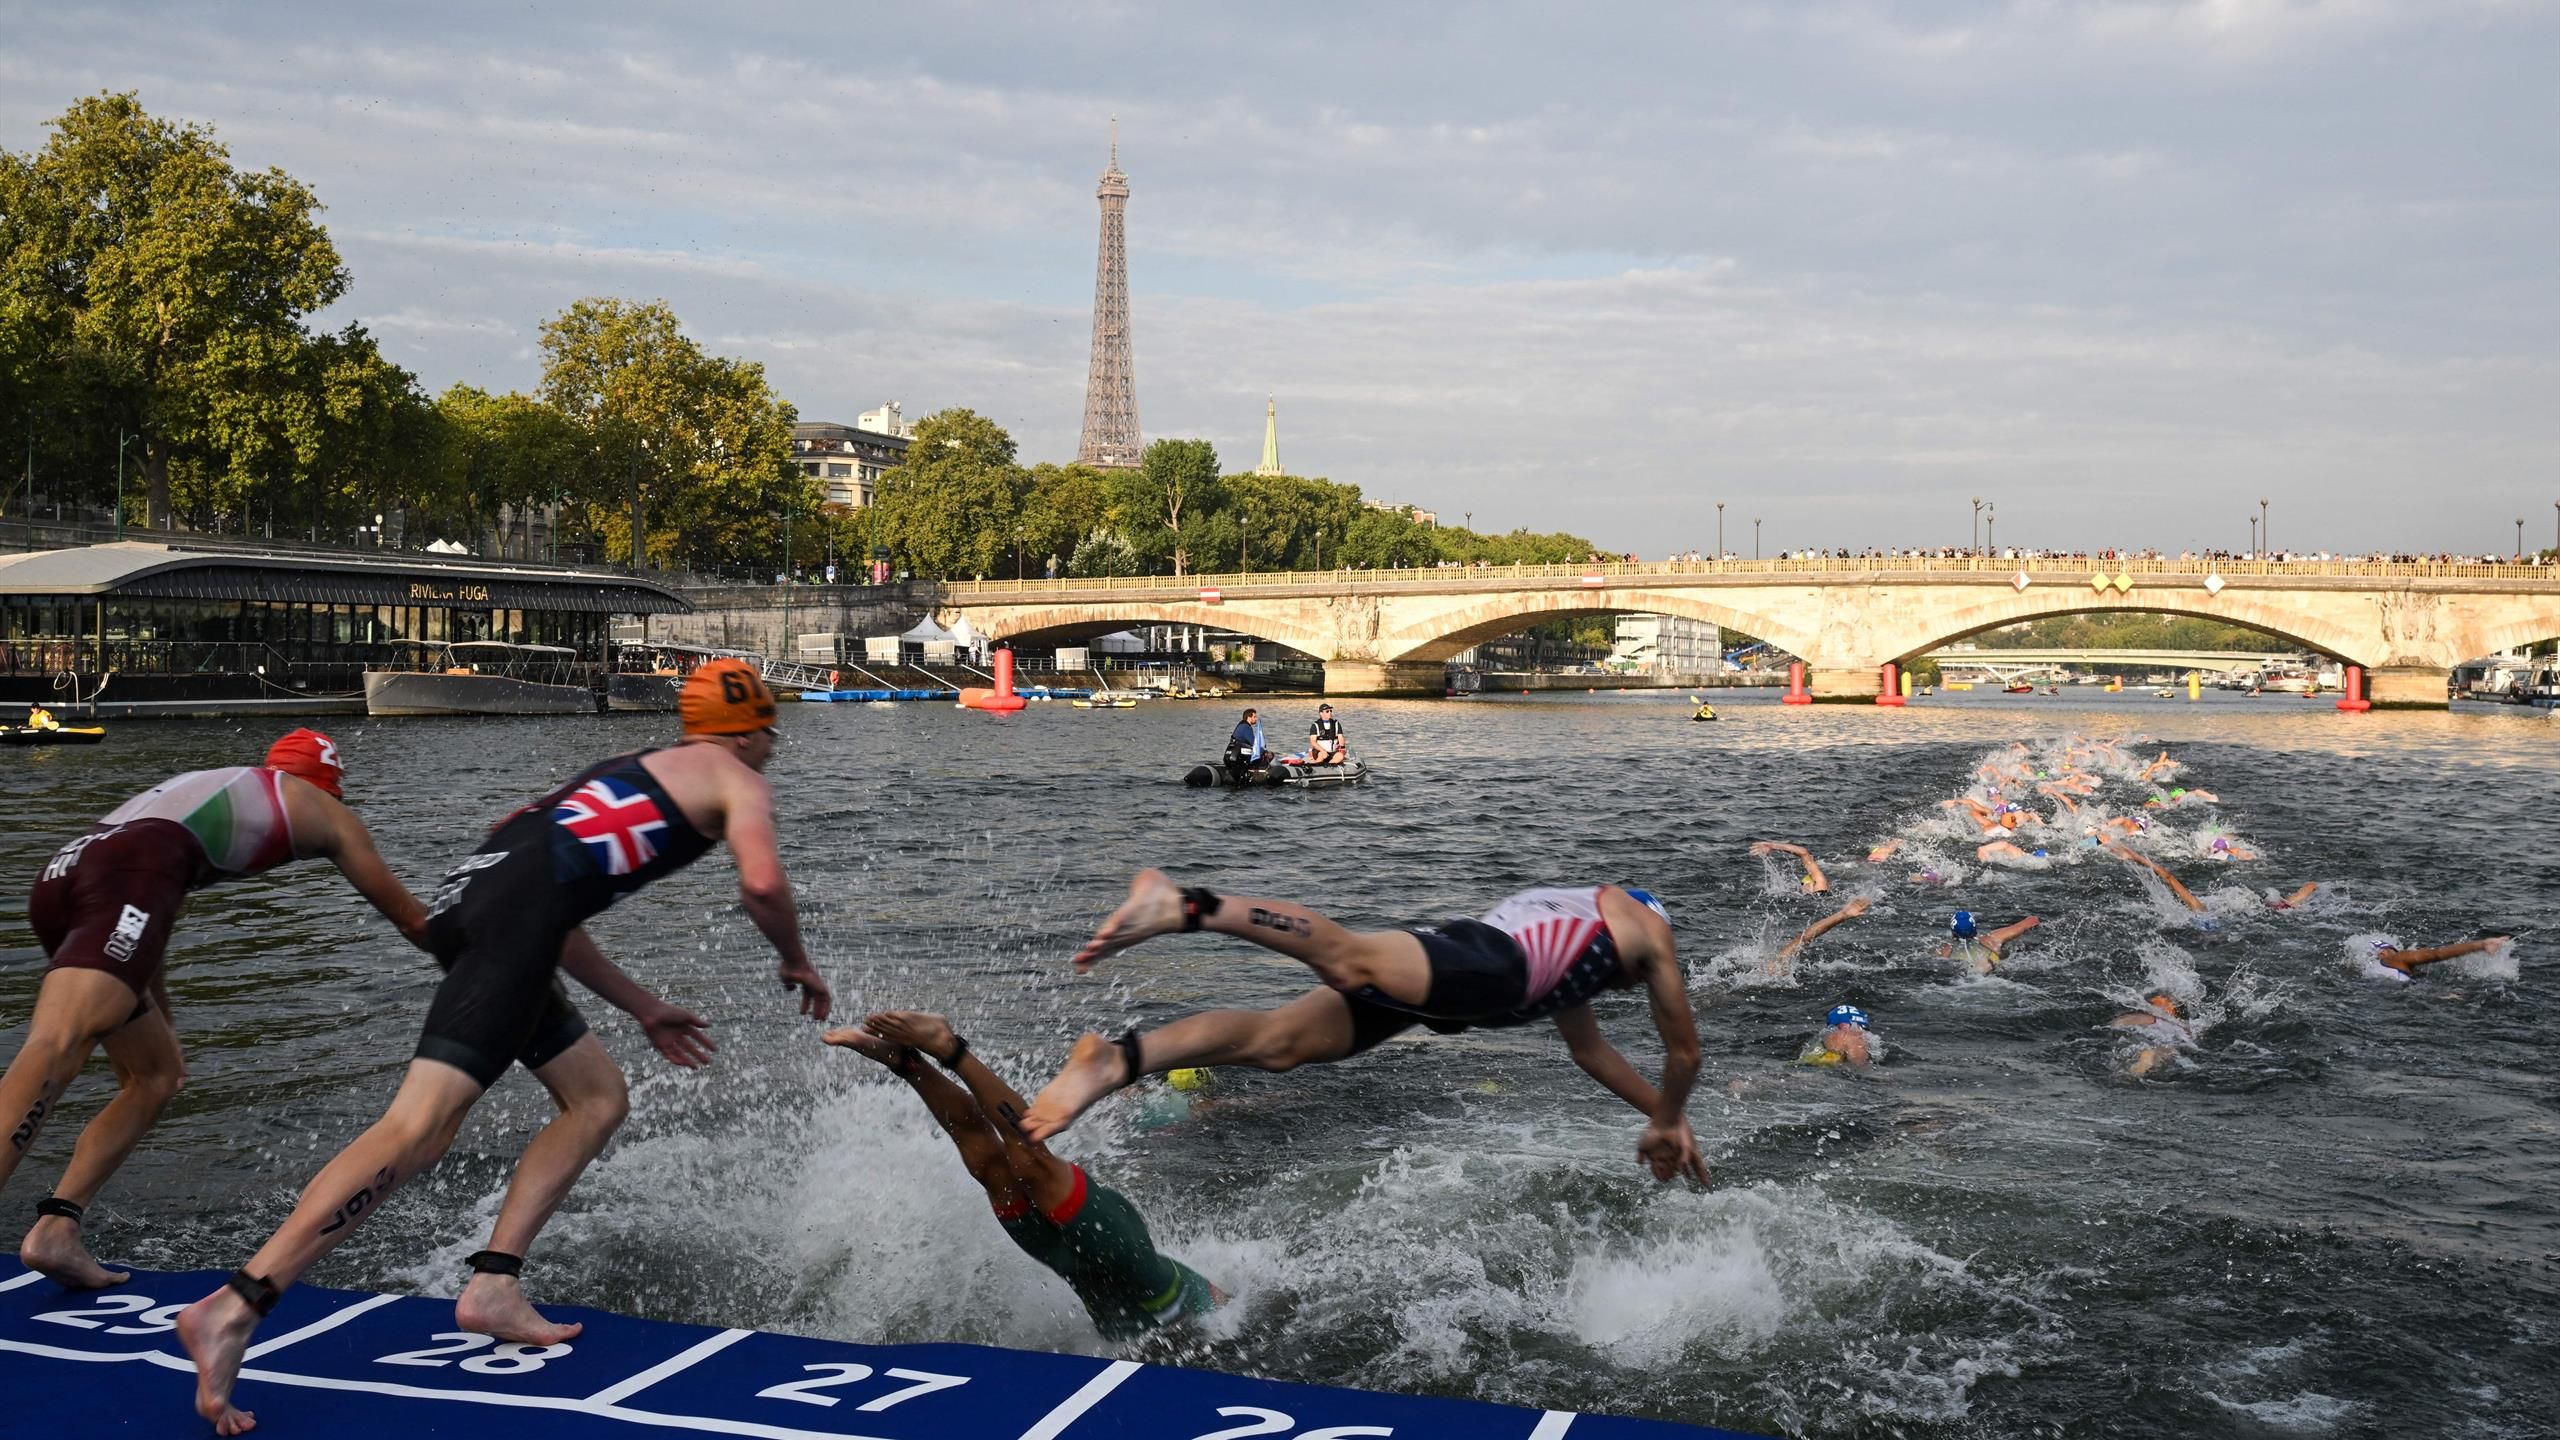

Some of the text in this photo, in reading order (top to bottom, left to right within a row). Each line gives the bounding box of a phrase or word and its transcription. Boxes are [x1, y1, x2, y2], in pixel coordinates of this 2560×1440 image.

[460, 585, 489, 601] FUGA
[314, 736, 345, 768] 2
[1837, 1004, 1860, 1015] 32
[373, 1332, 573, 1374] 28
[755, 1363, 971, 1412] 27
